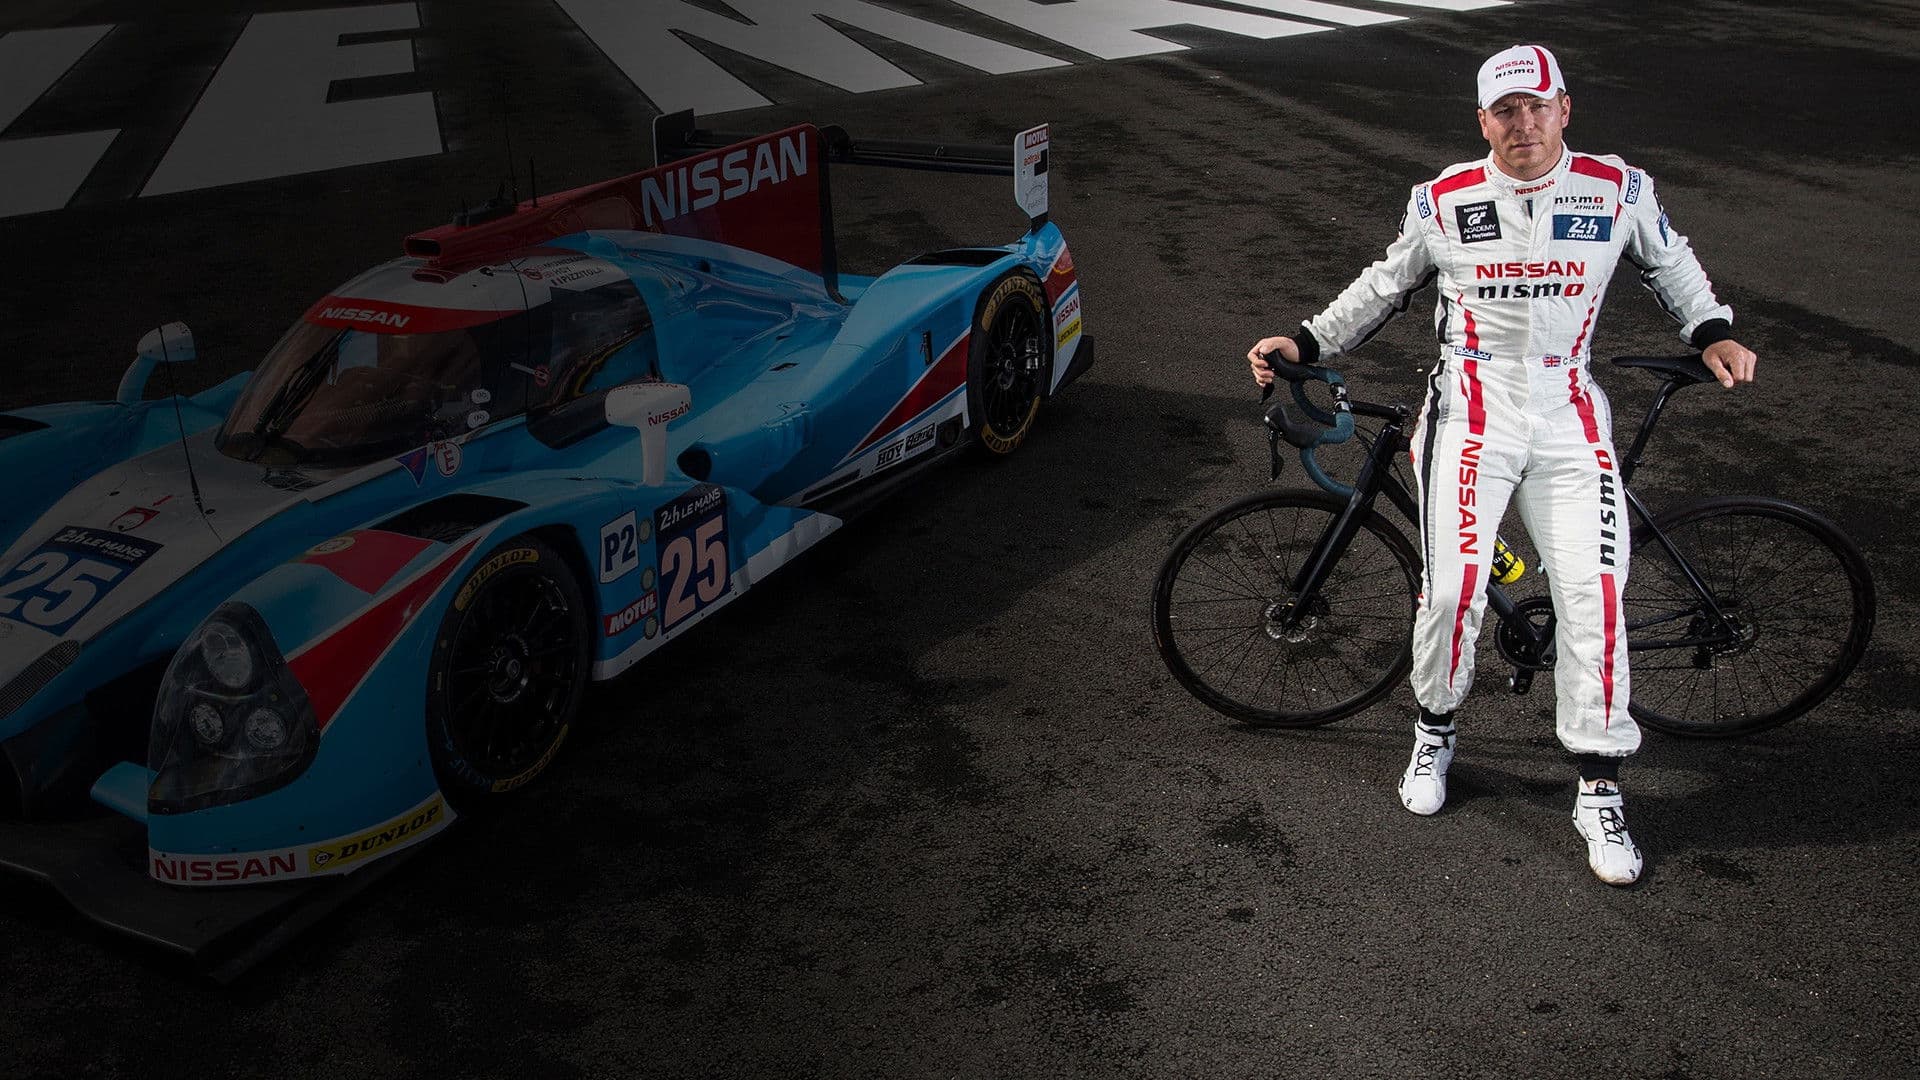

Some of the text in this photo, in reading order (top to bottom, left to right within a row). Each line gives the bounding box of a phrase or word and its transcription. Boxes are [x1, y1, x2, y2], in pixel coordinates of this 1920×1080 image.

[1495, 60, 1533, 71] NISSAN
[1495, 69, 1535, 79] nismo
[1026, 130, 1048, 147] MOTUL
[641, 130, 807, 227] NISSAN
[1515, 179, 1555, 195] NISSAN
[1464, 205, 1488, 213] NISSAN
[1555, 196, 1604, 204] nismo
[1464, 224, 1496, 233] ACADEMY
[1568, 217, 1599, 234] 24h
[1476, 261, 1585, 279] NISSAN
[1478, 283, 1585, 299] nismo
[318, 306, 411, 328] NISSAN
[648, 401, 691, 426] NISSAN
[877, 443, 904, 466] HOY
[681, 502, 695, 518] LE
[695, 488, 721, 509] MANS
[1459, 439, 1483, 555] NISSAN
[1594, 450, 1616, 566] nismo
[604, 525, 636, 572] P2
[471, 551, 531, 589] DUNLOP
[661, 514, 727, 628] 25
[0, 552, 124, 626] 25
[609, 593, 657, 633] MOTUL
[338, 805, 442, 861] DUNLOP
[153, 852, 296, 882] NISSAN
